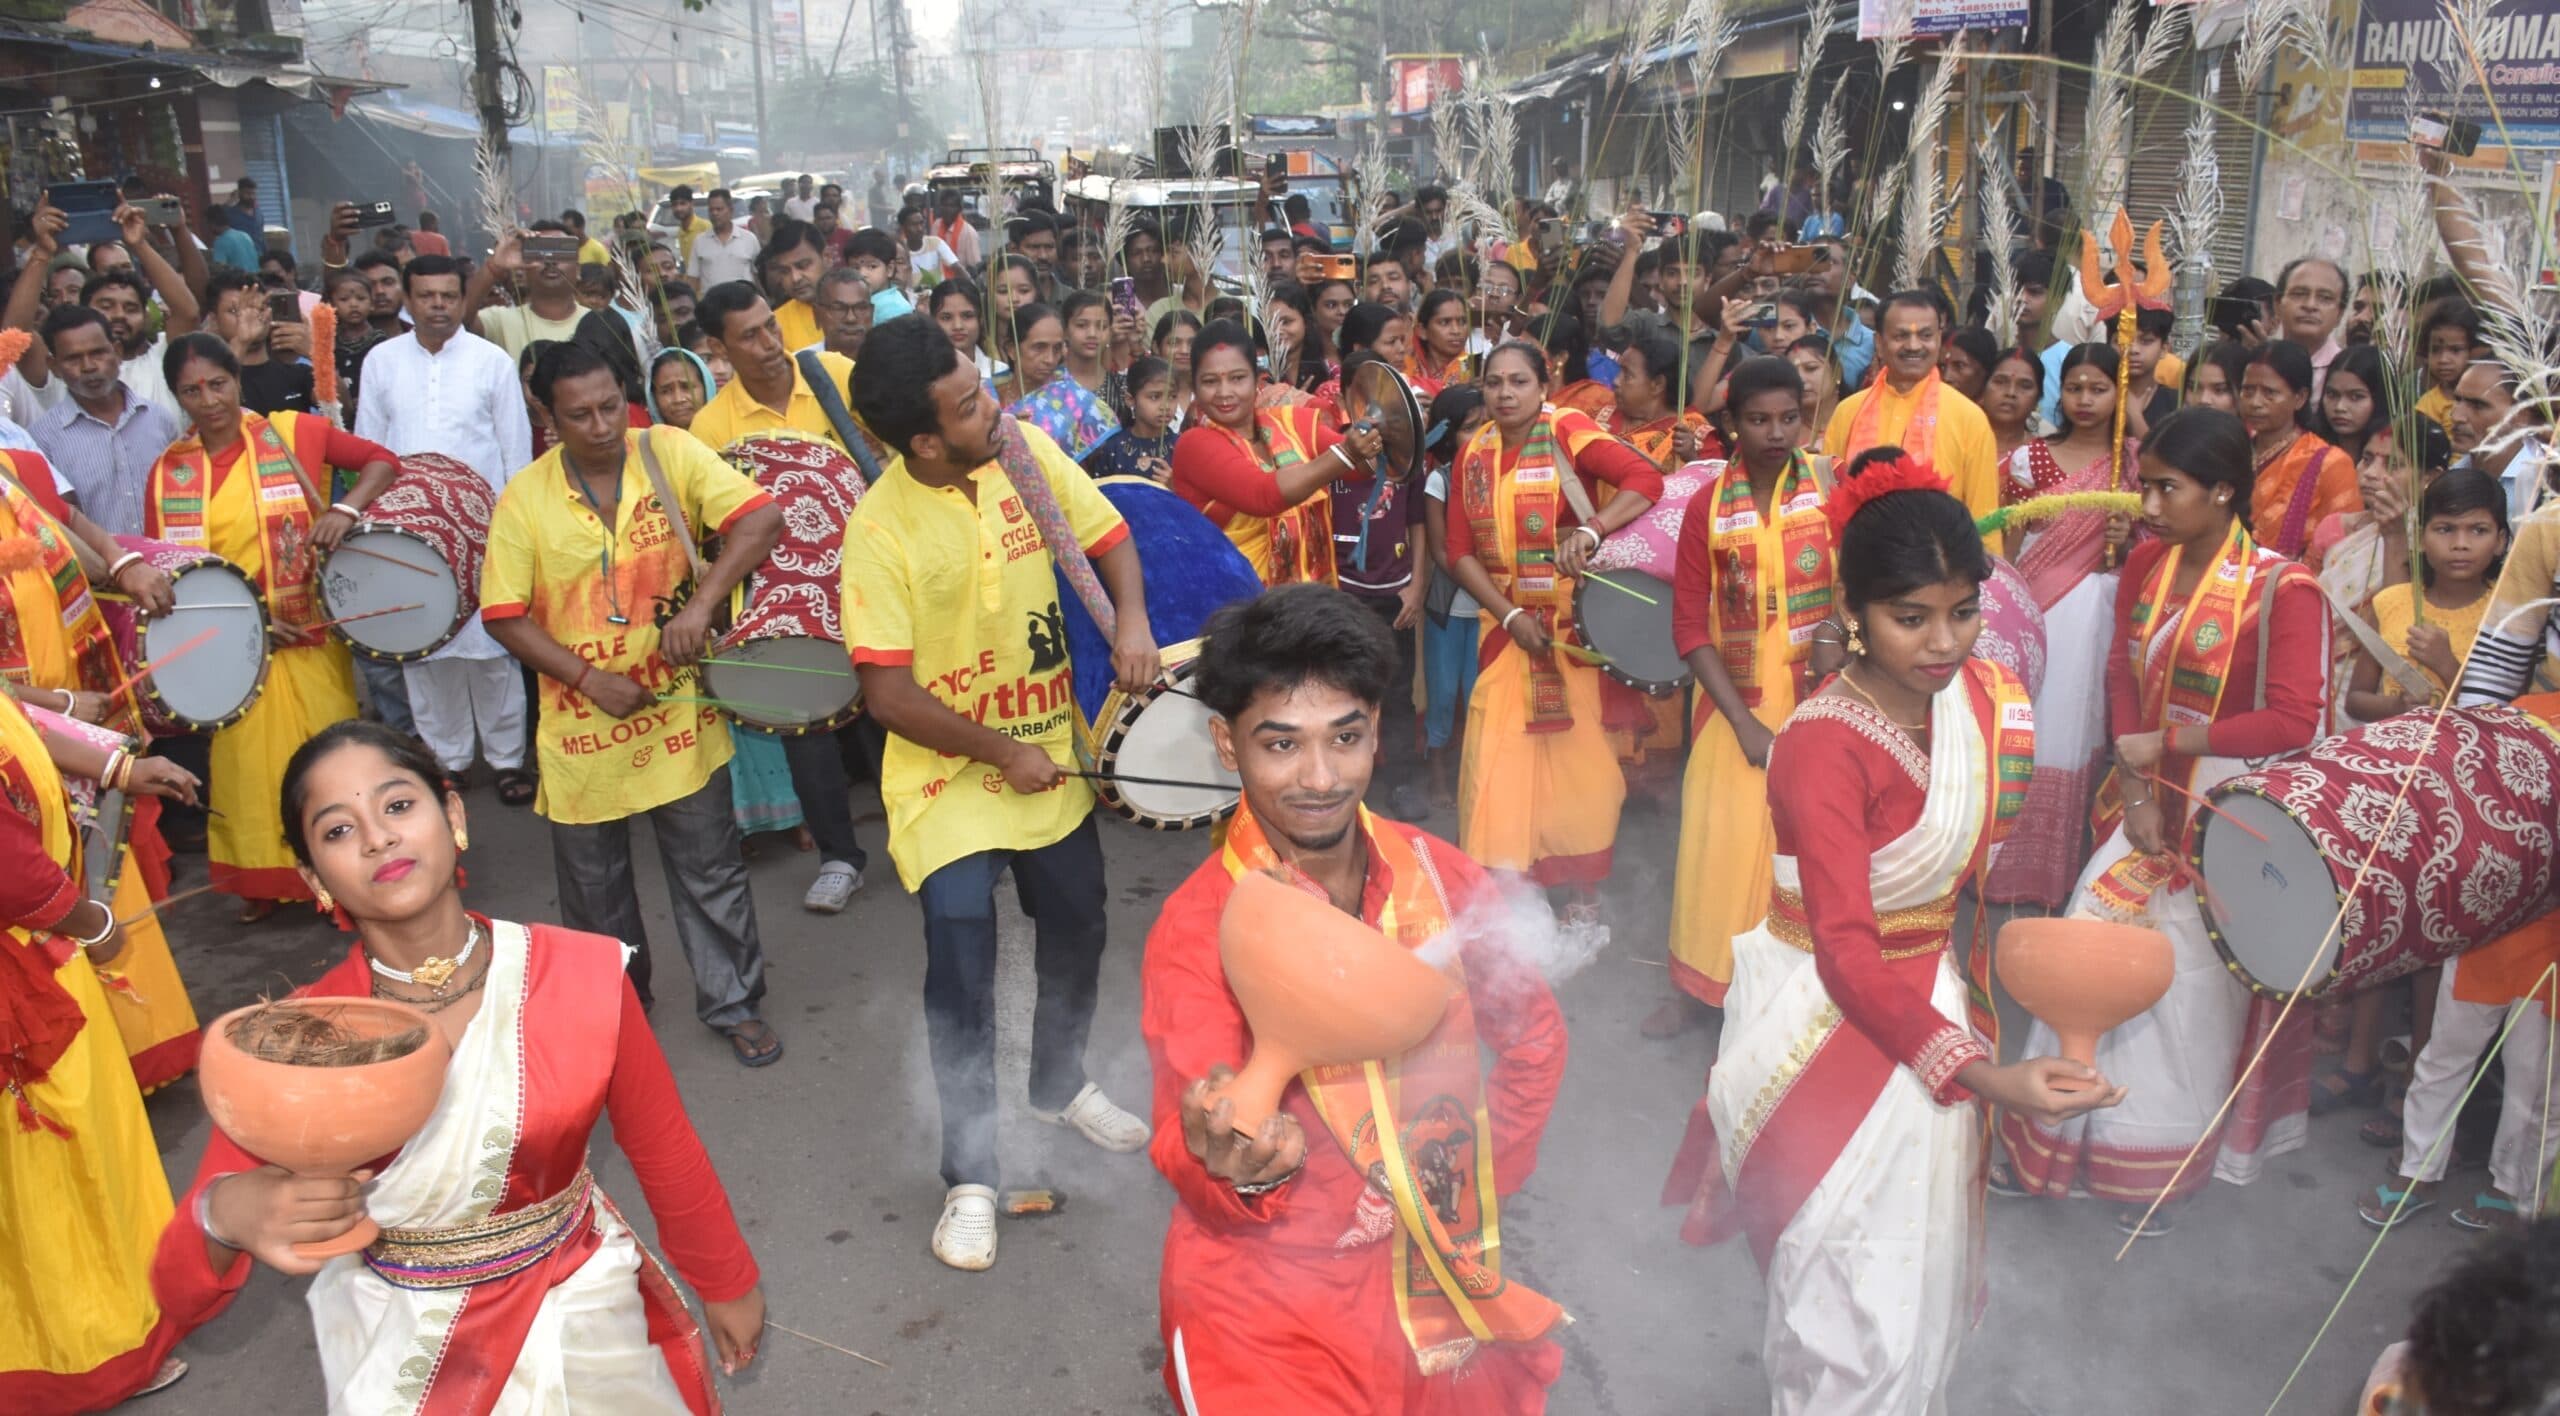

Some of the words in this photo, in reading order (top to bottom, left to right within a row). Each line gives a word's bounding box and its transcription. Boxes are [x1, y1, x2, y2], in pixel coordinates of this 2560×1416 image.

[2008, 18, 2023, 26] City
[1001, 523, 1036, 548] CYCLE
[1007, 537, 1048, 564] AGARBA
[562, 707, 670, 756] MELODY
[632, 744, 654, 768] &
